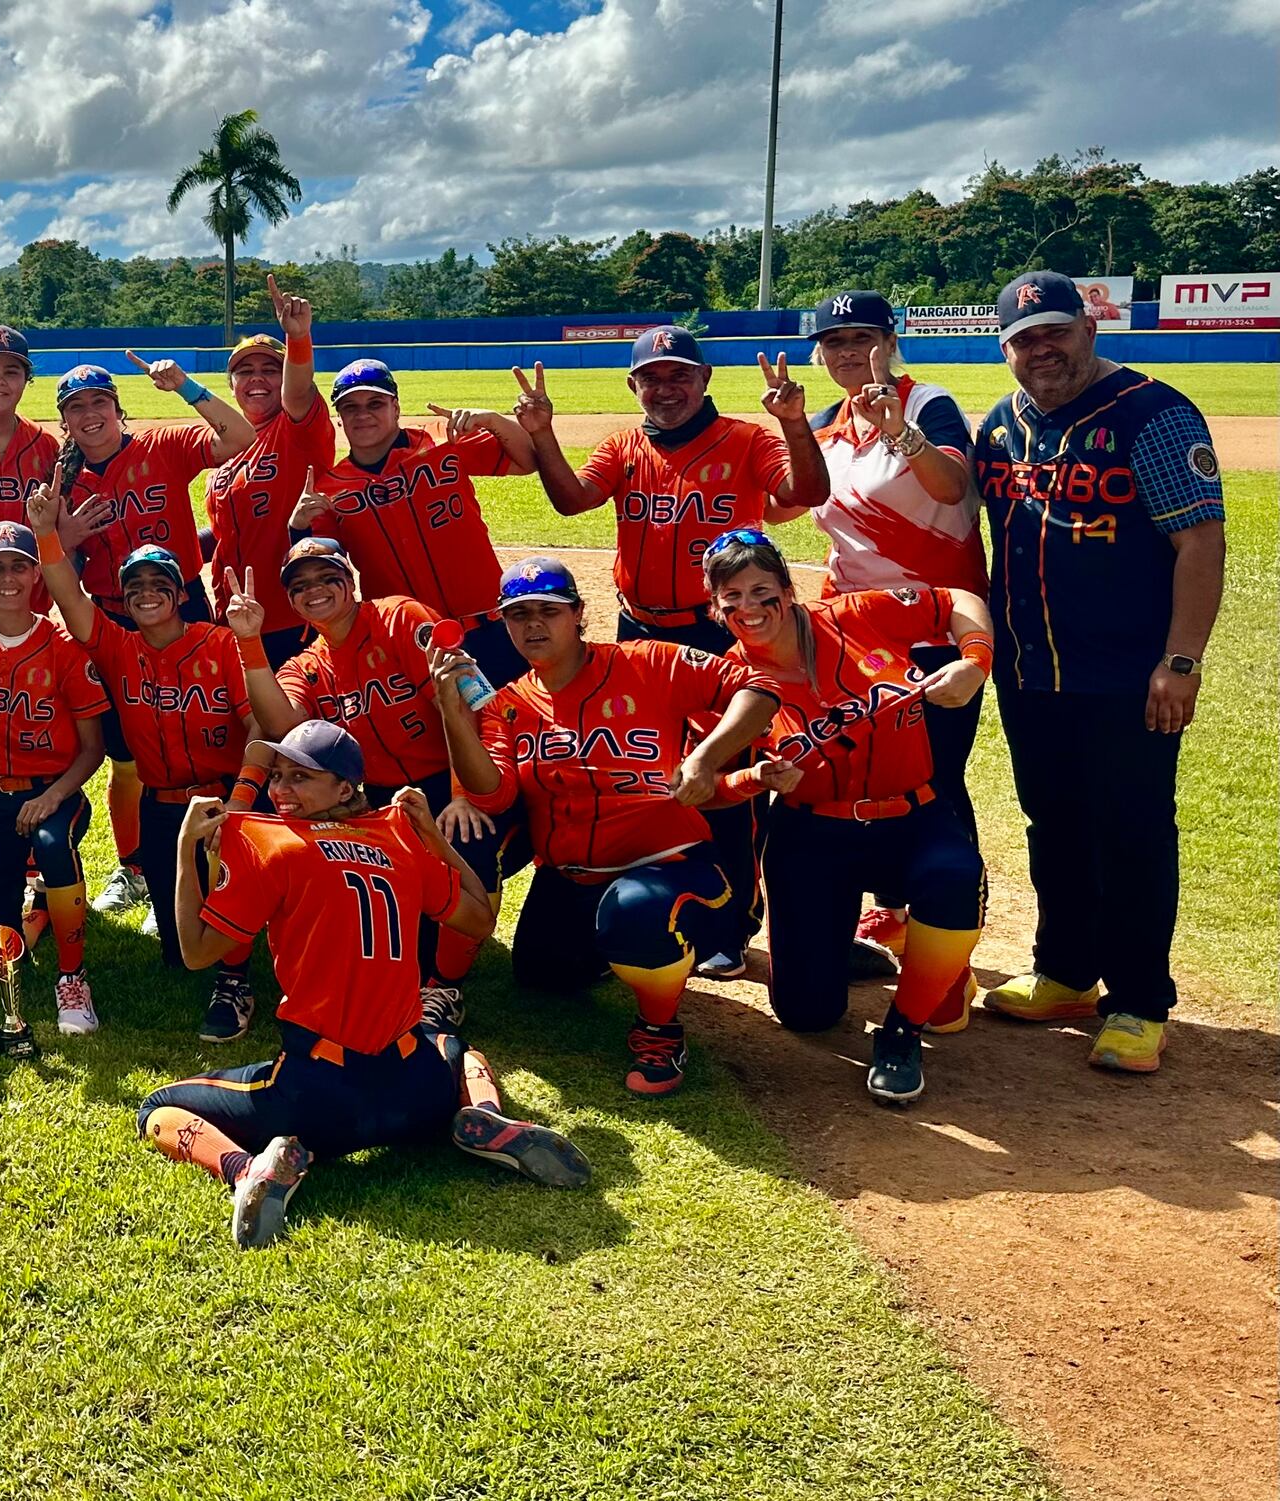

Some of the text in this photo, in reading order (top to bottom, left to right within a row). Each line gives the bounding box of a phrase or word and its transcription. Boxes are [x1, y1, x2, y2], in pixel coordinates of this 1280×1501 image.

[1175, 282, 1270, 303] MVP
[909, 306, 999, 317] MARGARO LOPE
[567, 330, 617, 338] ECONO
[331, 453, 460, 516] OBAS
[250, 491, 271, 518] 2
[426, 492, 464, 530] 20
[617, 490, 738, 525] OBAS
[1070, 512, 1118, 544] 14
[122, 675, 232, 715] LOBAS
[317, 673, 417, 722] OBAS
[19, 729, 54, 751] 54
[201, 725, 228, 749] 18
[399, 711, 427, 740] 5
[515, 727, 660, 765] OBAS
[608, 770, 672, 796] 25
[315, 840, 395, 871] RIVERA
[342, 870, 403, 962] 11
